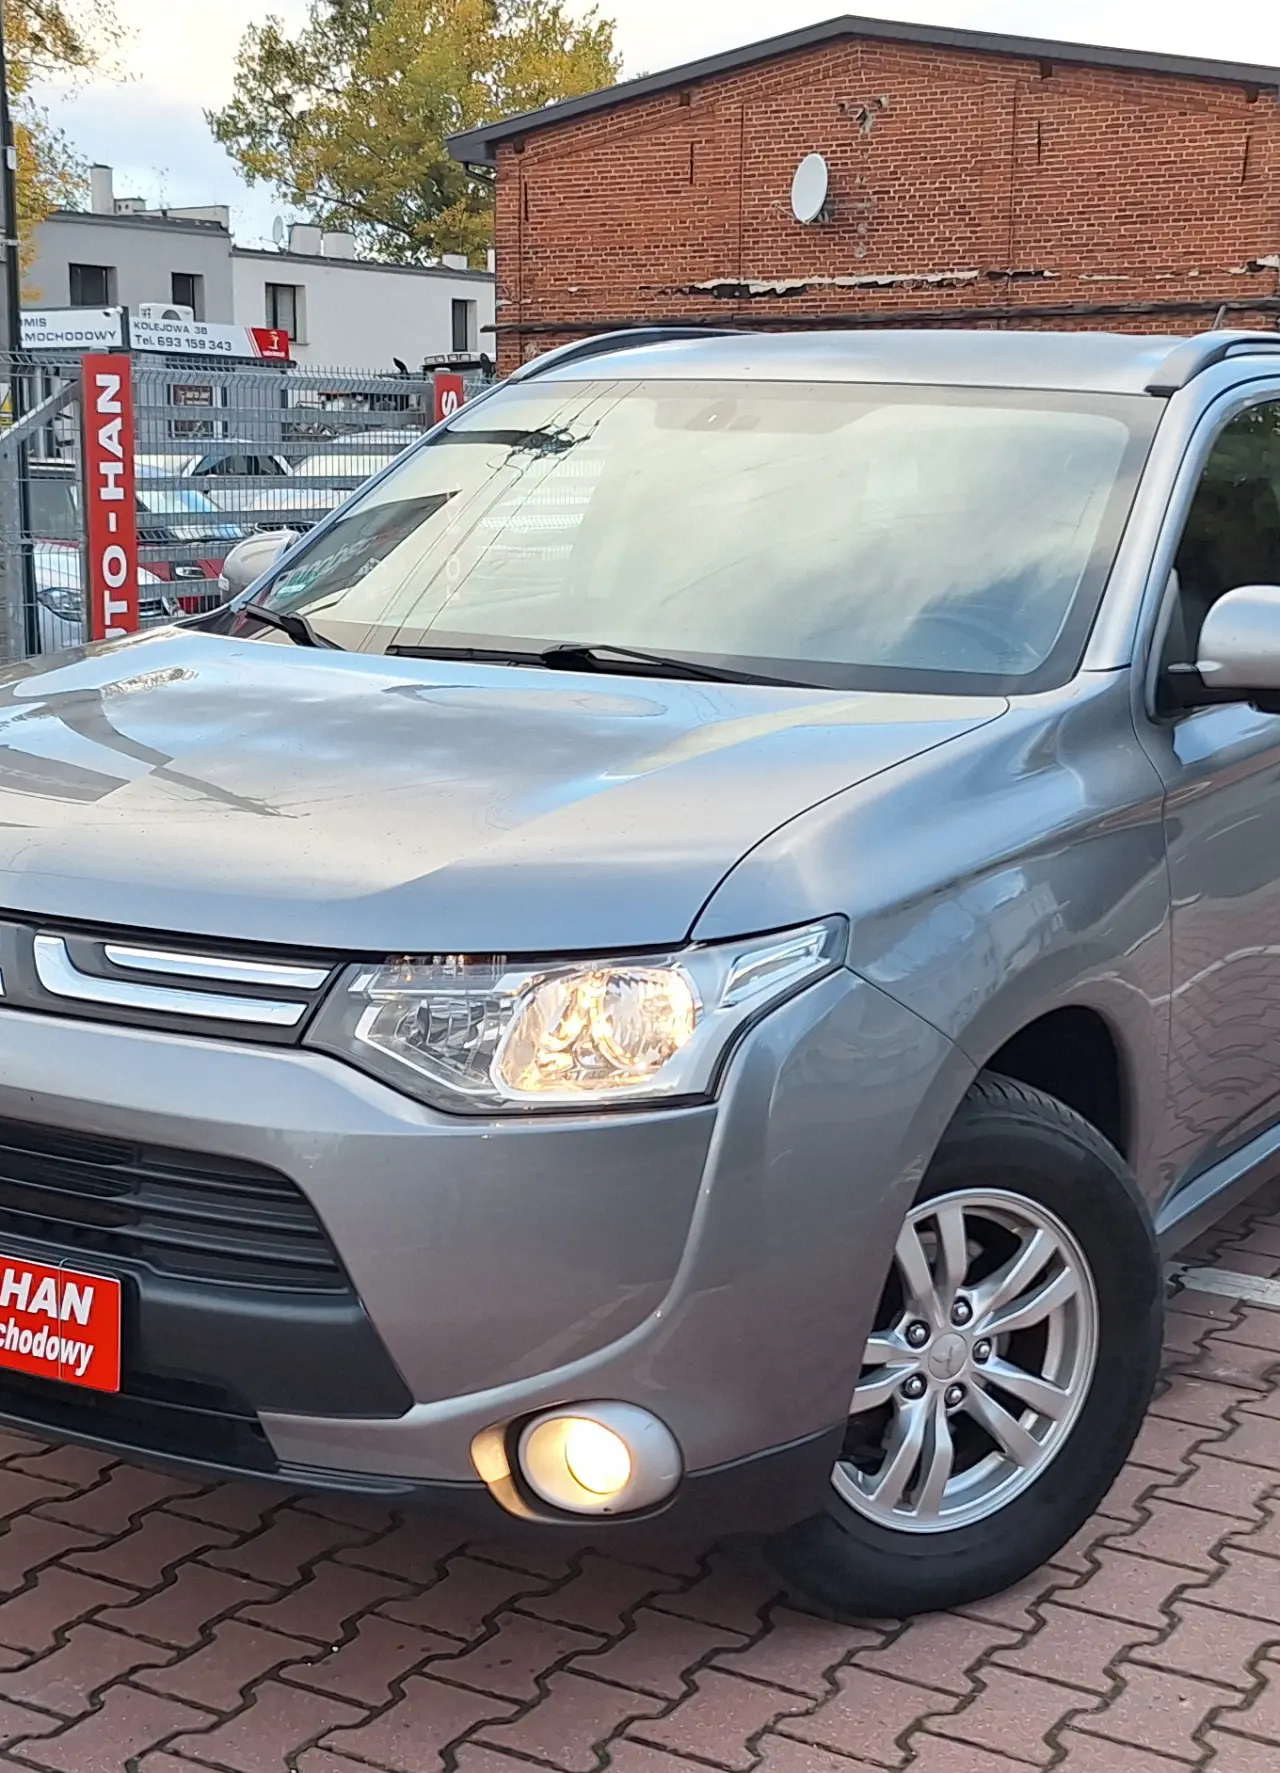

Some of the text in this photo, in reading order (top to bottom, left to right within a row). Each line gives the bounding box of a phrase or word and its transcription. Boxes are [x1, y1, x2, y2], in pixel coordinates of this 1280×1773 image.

[21, 318, 47, 328] MIS
[134, 321, 190, 335] KOLEJOWA
[21, 331, 117, 342] MOCHODOWY
[135, 334, 232, 351] Tel. 693 159 343
[95, 374, 129, 640] TO-HAN
